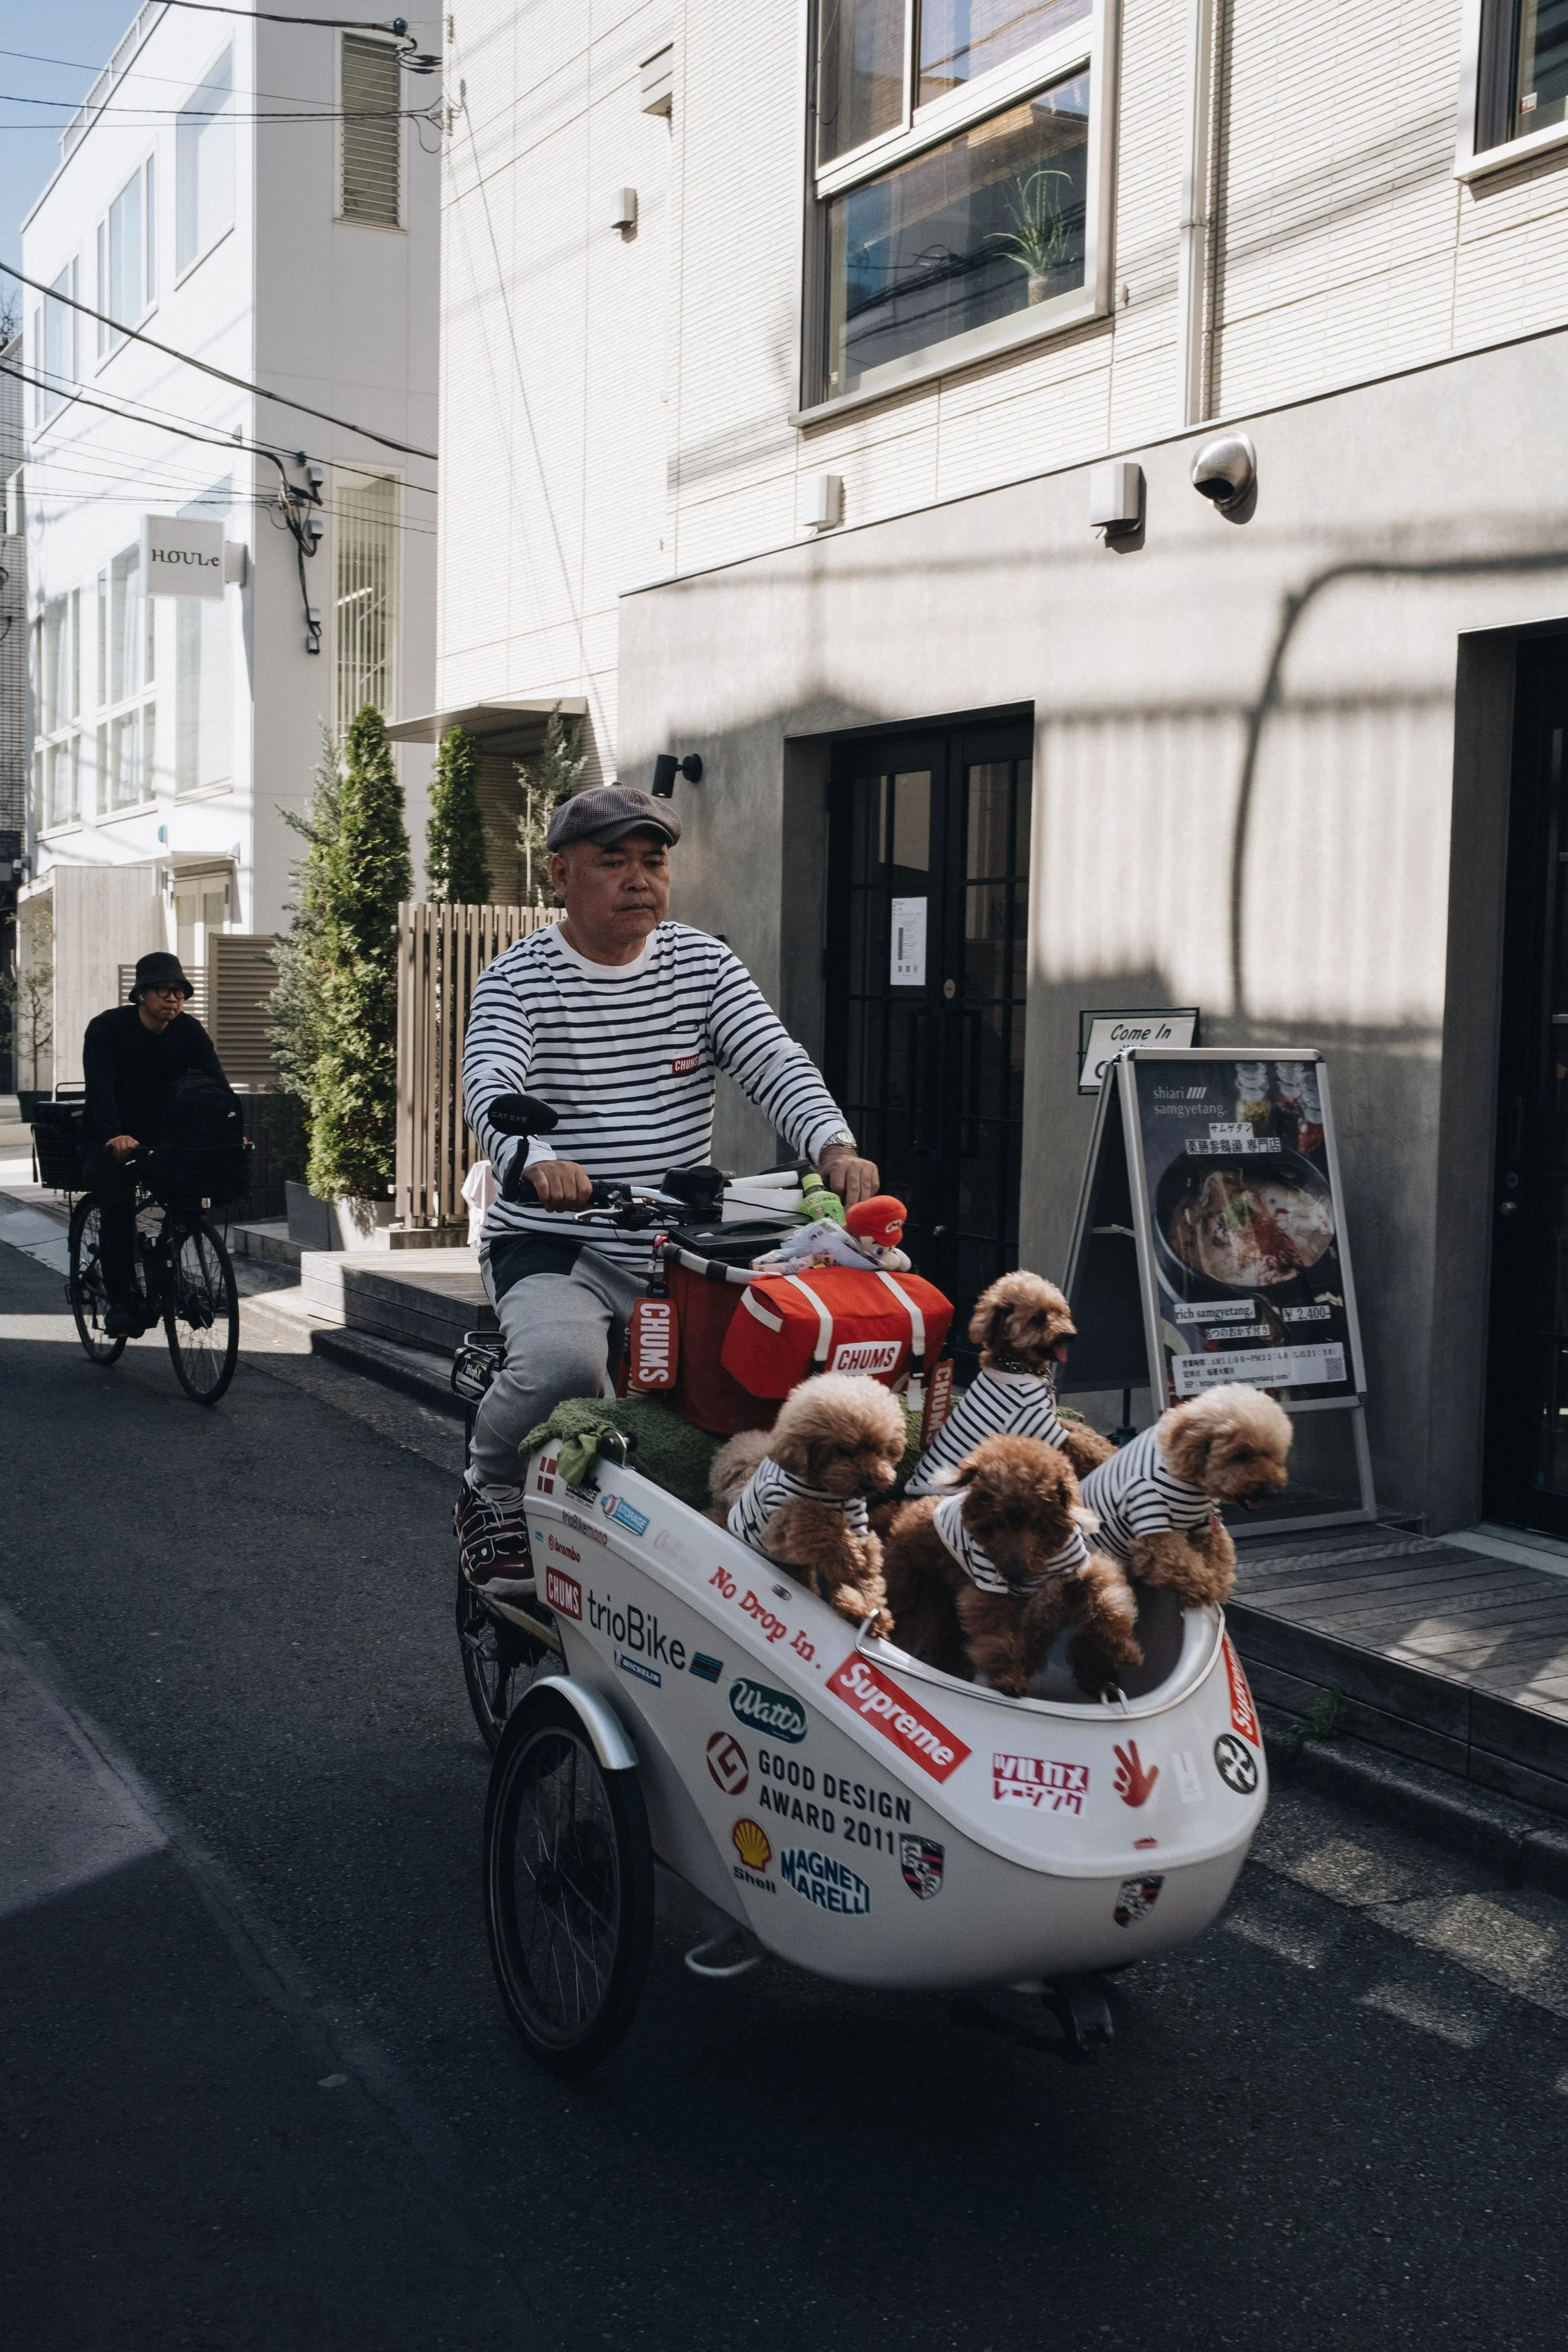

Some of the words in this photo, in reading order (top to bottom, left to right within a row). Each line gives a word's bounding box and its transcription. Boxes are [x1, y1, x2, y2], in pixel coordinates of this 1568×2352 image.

[1111, 1024, 1151, 1041] Come
[1155, 1024, 1172, 1039] In
[675, 1056, 698, 1071] CHUMS
[1153, 1086, 1184, 1099] shiari
[1153, 1104, 1227, 1118] samgyetang.
[1175, 1308, 1195, 1319] rich
[638, 1303, 671, 1382] CHUMS
[837, 1347, 896, 1370] CHUMS
[548, 1572, 579, 1615] CHUMS
[708, 1566, 737, 1599] No
[738, 1589, 787, 1644] Drop
[588, 1589, 686, 1670] trioBike
[734, 1680, 806, 1735] Watts
[840, 1663, 955, 1766] Supreme
[758, 1749, 815, 1791] GOOD
[824, 1773, 911, 1825] DESIGN
[759, 1785, 835, 1834] AWARD
[844, 1816, 895, 1855] 2011
[733, 1865, 776, 1894] Shell
